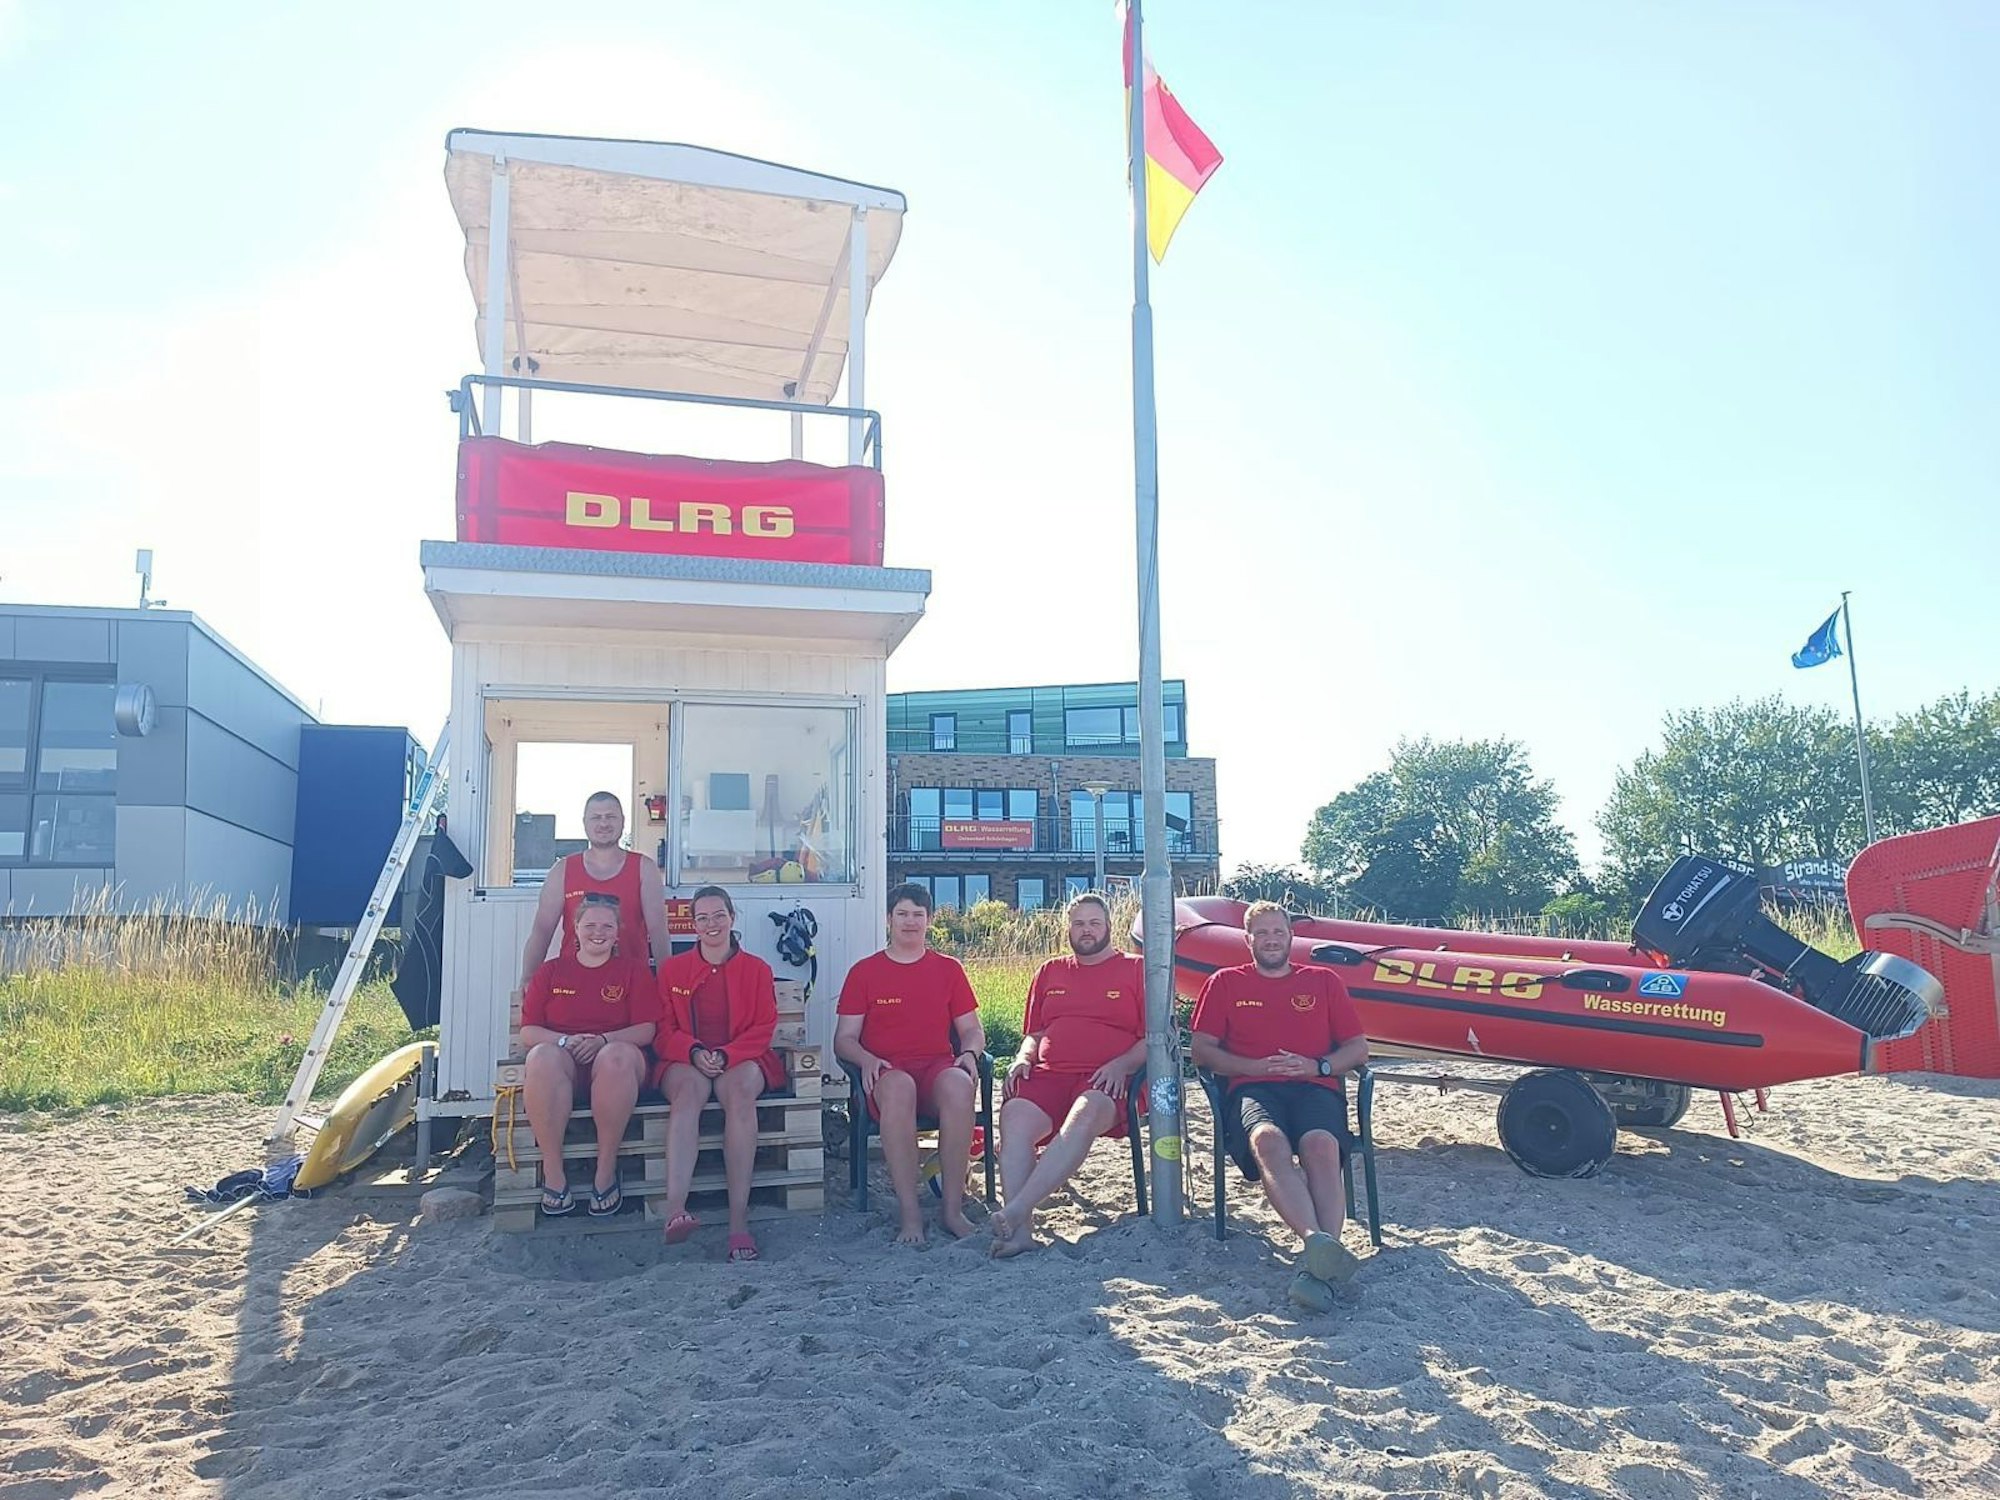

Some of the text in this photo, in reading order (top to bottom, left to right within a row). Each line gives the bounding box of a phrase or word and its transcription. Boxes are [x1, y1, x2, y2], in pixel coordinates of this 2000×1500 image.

[566, 491, 795, 539] DLRG
[944, 825, 1031, 835] DLRG Wasserrettung
[1676, 865, 1713, 903] TOHATSU
[1784, 859, 1848, 882] Strand-Ba
[1373, 958, 1544, 1000] DLRG
[1583, 993, 1726, 1027] Wasserrettung
